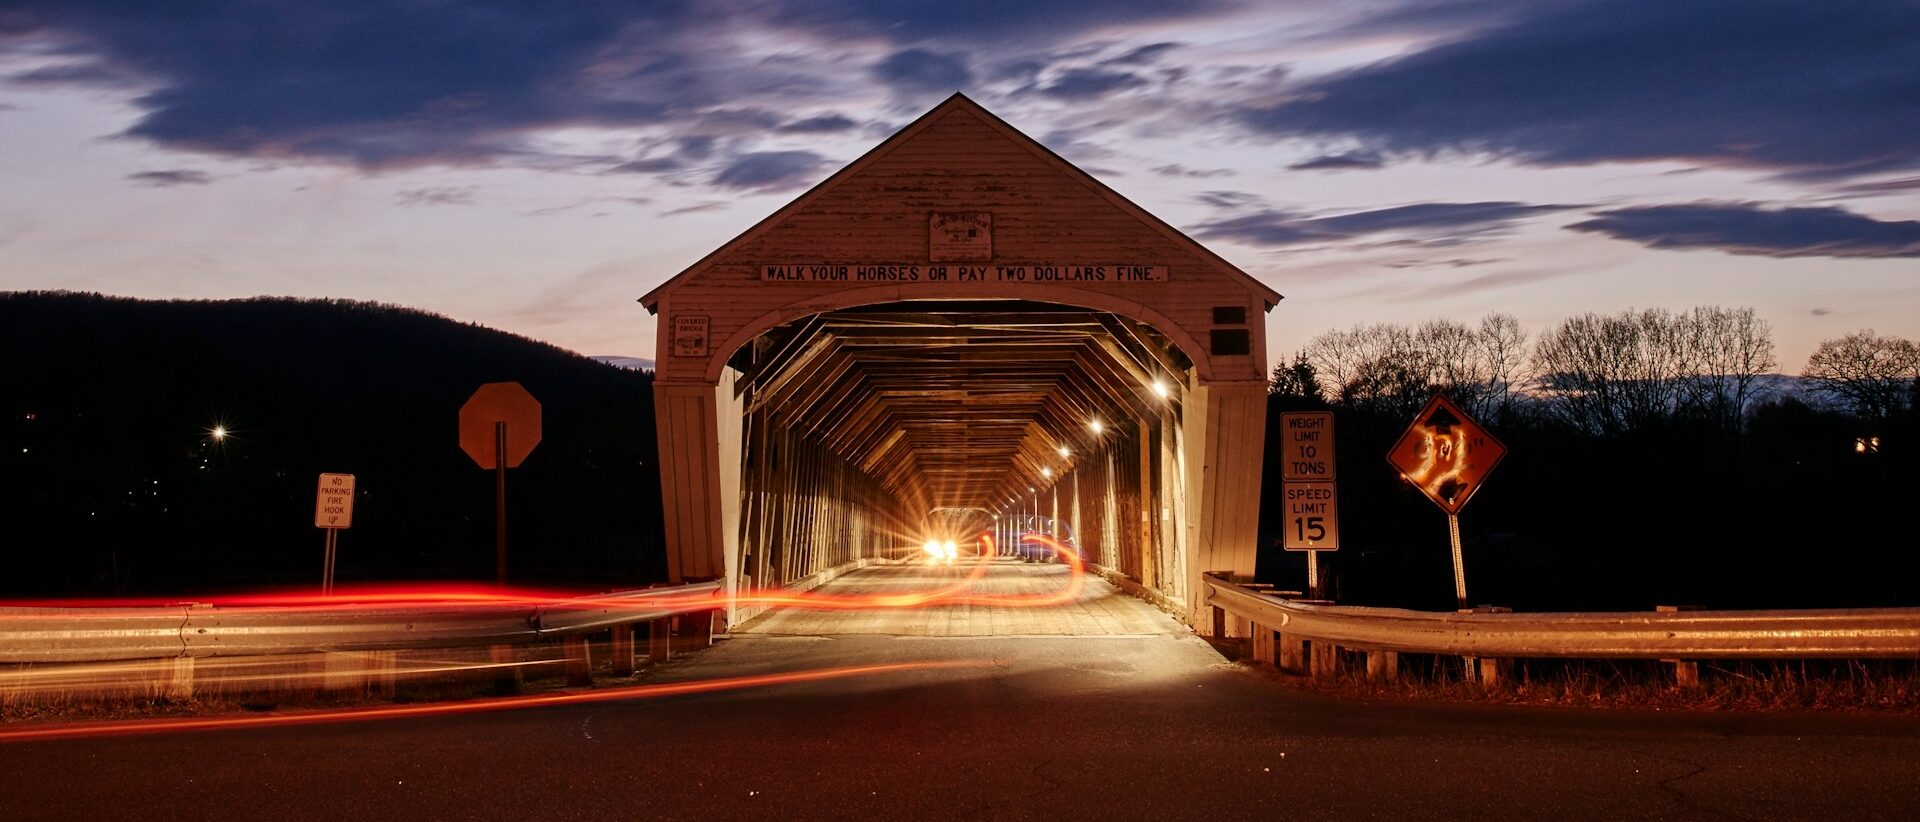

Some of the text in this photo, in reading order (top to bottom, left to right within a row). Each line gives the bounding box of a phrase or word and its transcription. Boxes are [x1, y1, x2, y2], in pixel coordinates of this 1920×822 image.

[767, 266, 1162, 281] WALK YOUR HORSES OR PAY TWO DOLLARS FINE.
[1288, 418, 1325, 429] WEIGHT
[1294, 432, 1320, 442] LIMIT
[1300, 446, 1317, 458] 10
[1292, 462, 1326, 475] TONS
[332, 477, 342, 486] NO
[321, 487, 351, 496] PARKING
[1288, 488, 1332, 500] SPEED
[324, 506, 344, 514] HOOK
[1293, 503, 1326, 514] LIMIT
[329, 516, 338, 524] UP
[1295, 517, 1326, 542] 15
